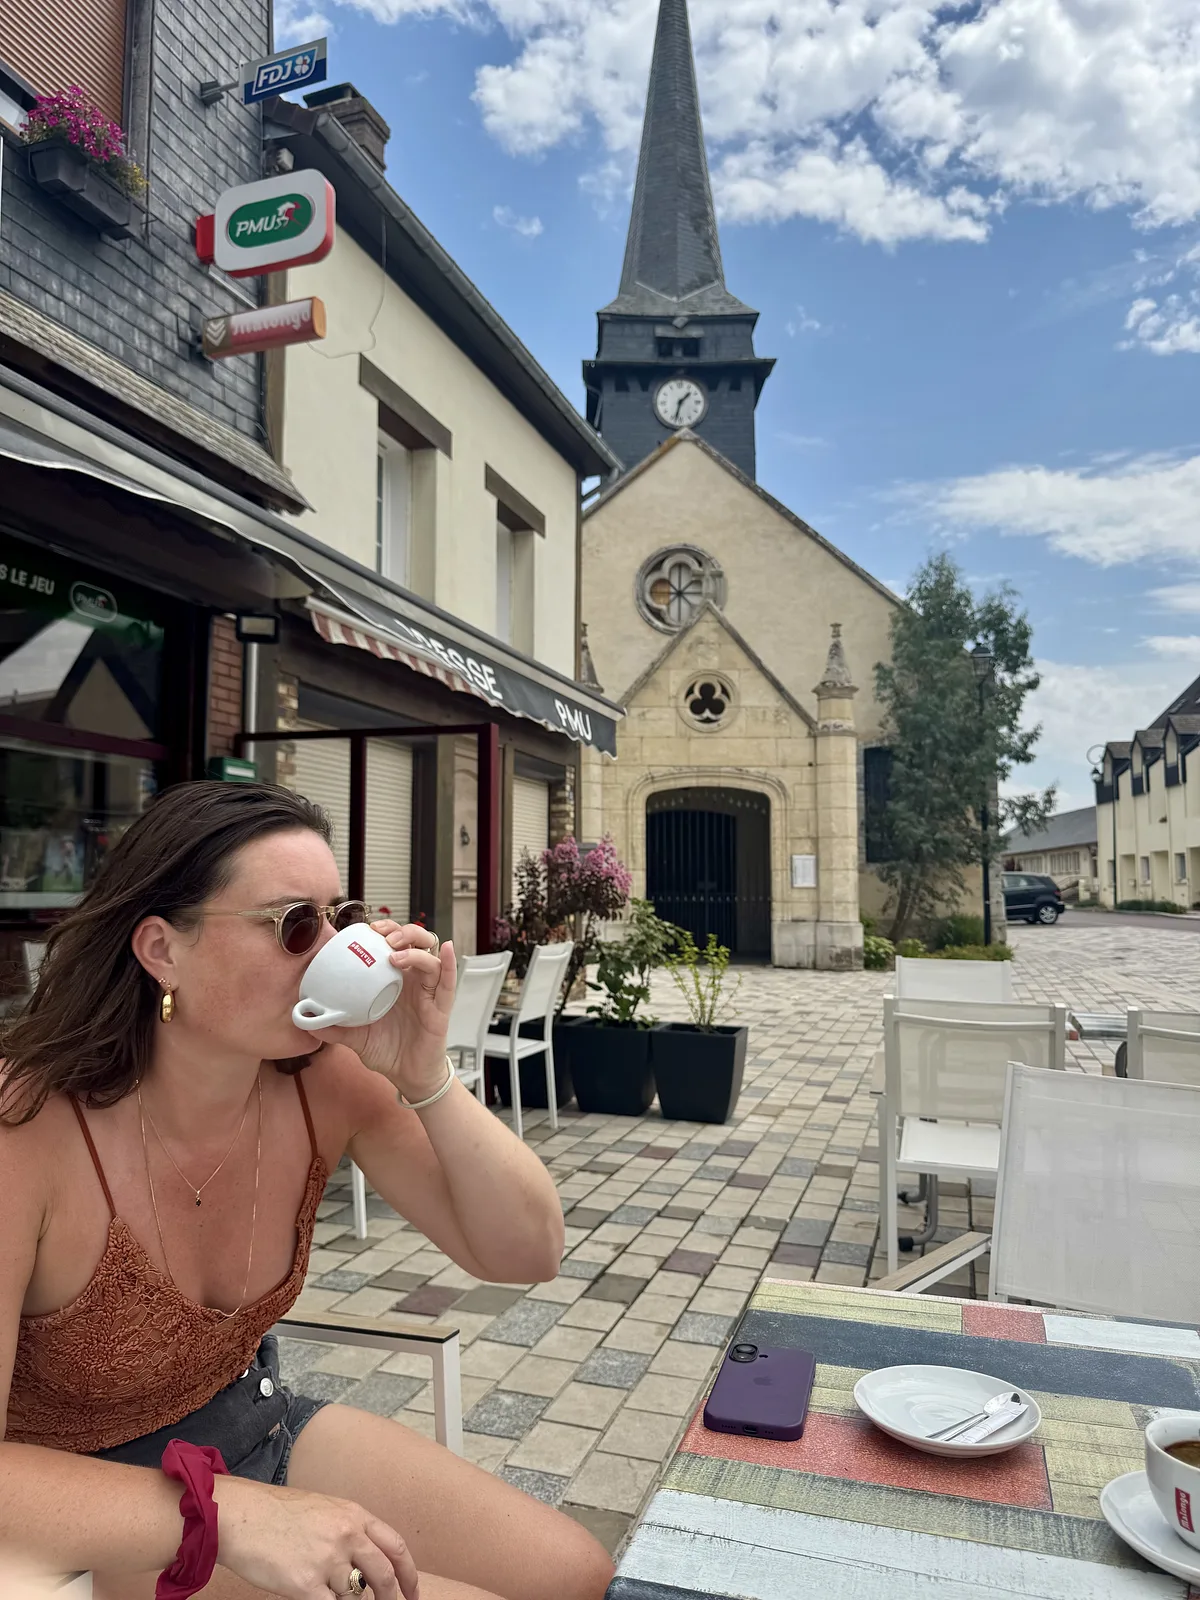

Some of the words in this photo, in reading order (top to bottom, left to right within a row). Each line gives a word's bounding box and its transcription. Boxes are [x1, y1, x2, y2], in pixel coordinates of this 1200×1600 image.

[258, 60, 293, 88] FDJ
[235, 214, 278, 238] PMU
[10, 567, 28, 587] LE
[29, 574, 55, 595] JEU
[394, 618, 503, 700] ESSE
[554, 699, 592, 741] PMU
[1179, 1491, 1191, 1530] Malongo
